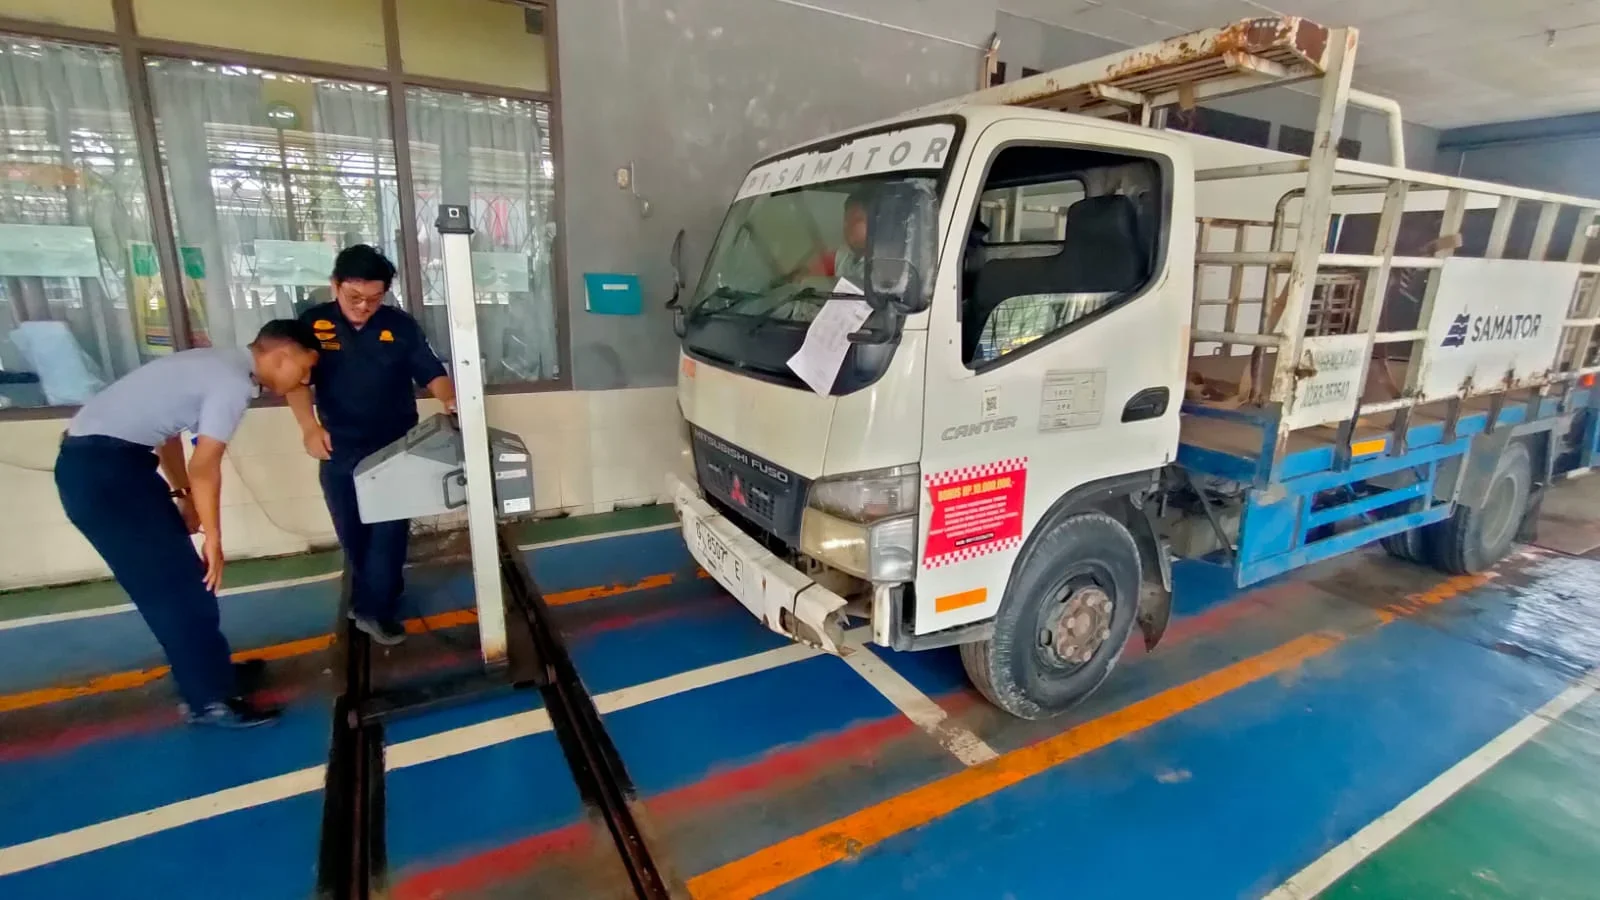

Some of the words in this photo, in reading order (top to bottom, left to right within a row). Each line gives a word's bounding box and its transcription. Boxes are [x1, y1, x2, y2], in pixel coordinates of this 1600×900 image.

[1471, 313, 1542, 342] SAMATOR
[941, 416, 1018, 442] CANTER
[693, 429, 748, 465] MITSUBISHI
[751, 459, 788, 484] FUSO
